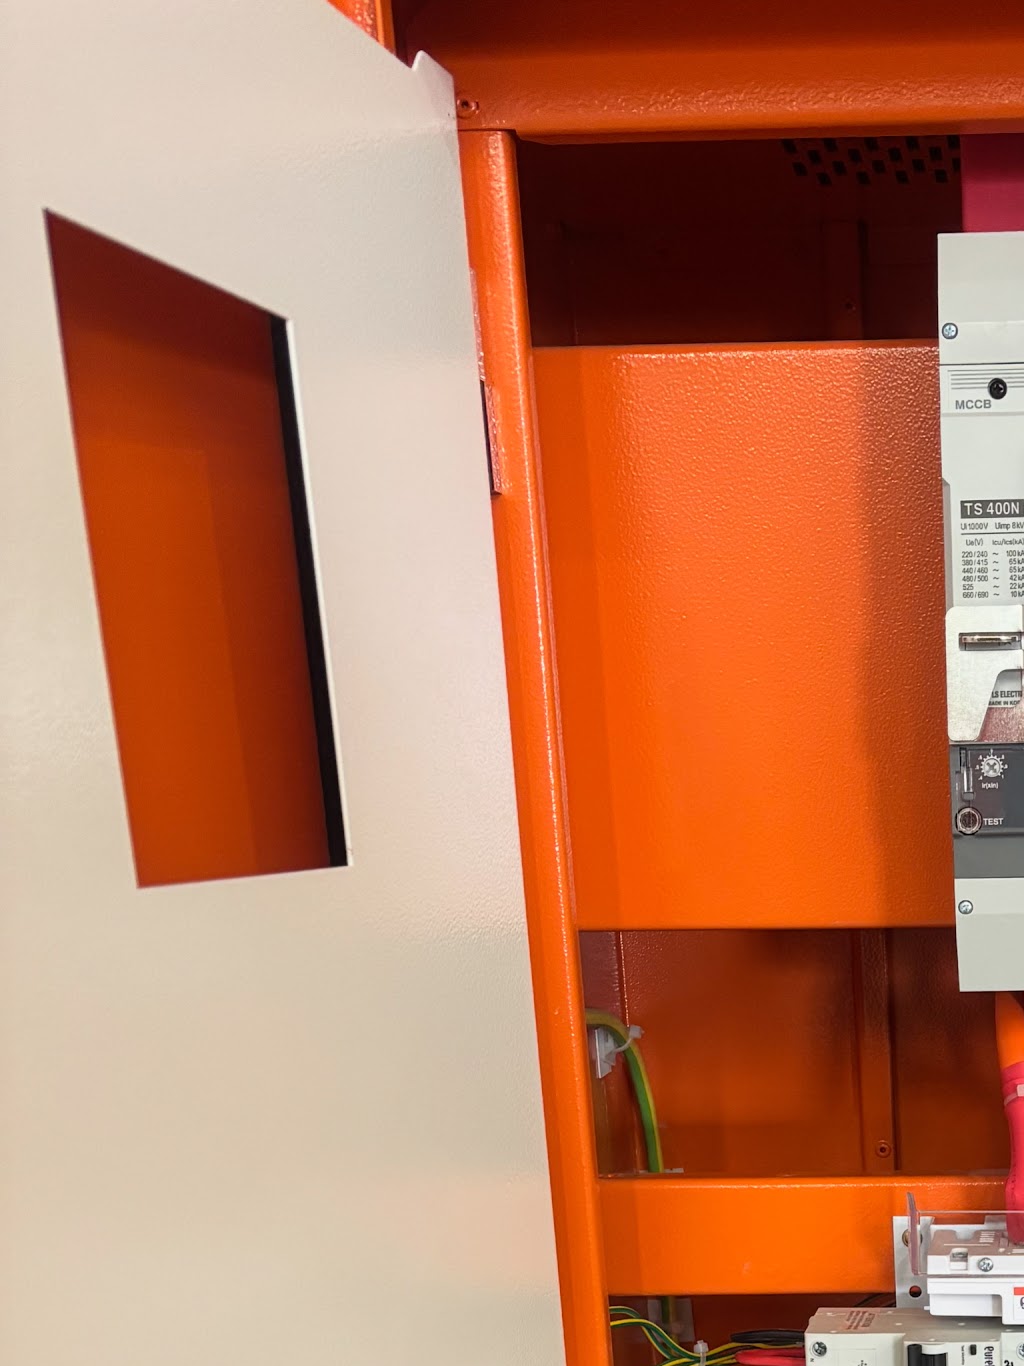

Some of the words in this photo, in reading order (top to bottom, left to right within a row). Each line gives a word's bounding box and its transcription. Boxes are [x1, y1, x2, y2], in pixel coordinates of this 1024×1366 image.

[955, 399, 992, 410] MCCB
[963, 502, 983, 516] TS
[986, 501, 1020, 515] 400N
[983, 817, 1004, 826] TEST
